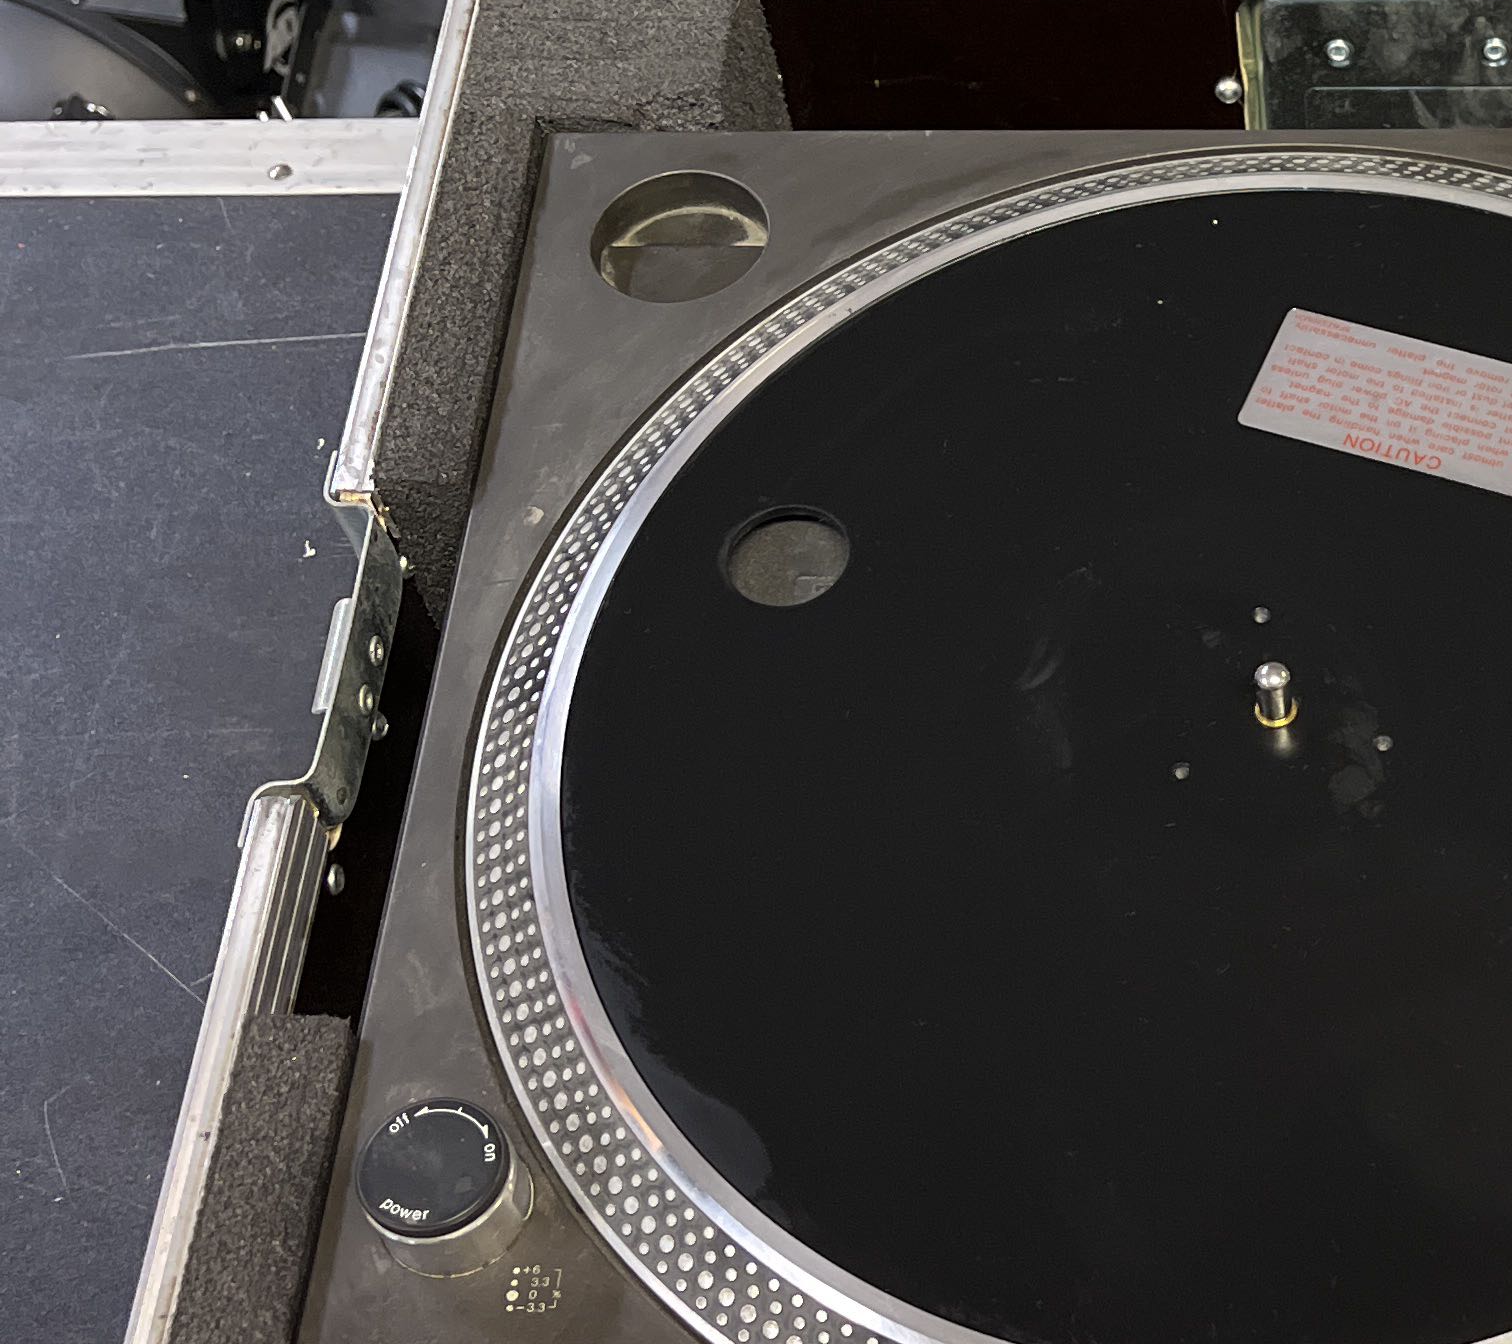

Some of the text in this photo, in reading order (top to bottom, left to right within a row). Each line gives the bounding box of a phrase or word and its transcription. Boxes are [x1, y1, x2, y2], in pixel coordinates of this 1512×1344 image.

[1340, 431, 1444, 472] CAUTION
[388, 1112, 411, 1134] off
[483, 1143, 496, 1163] on
[378, 1197, 430, 1221] power
